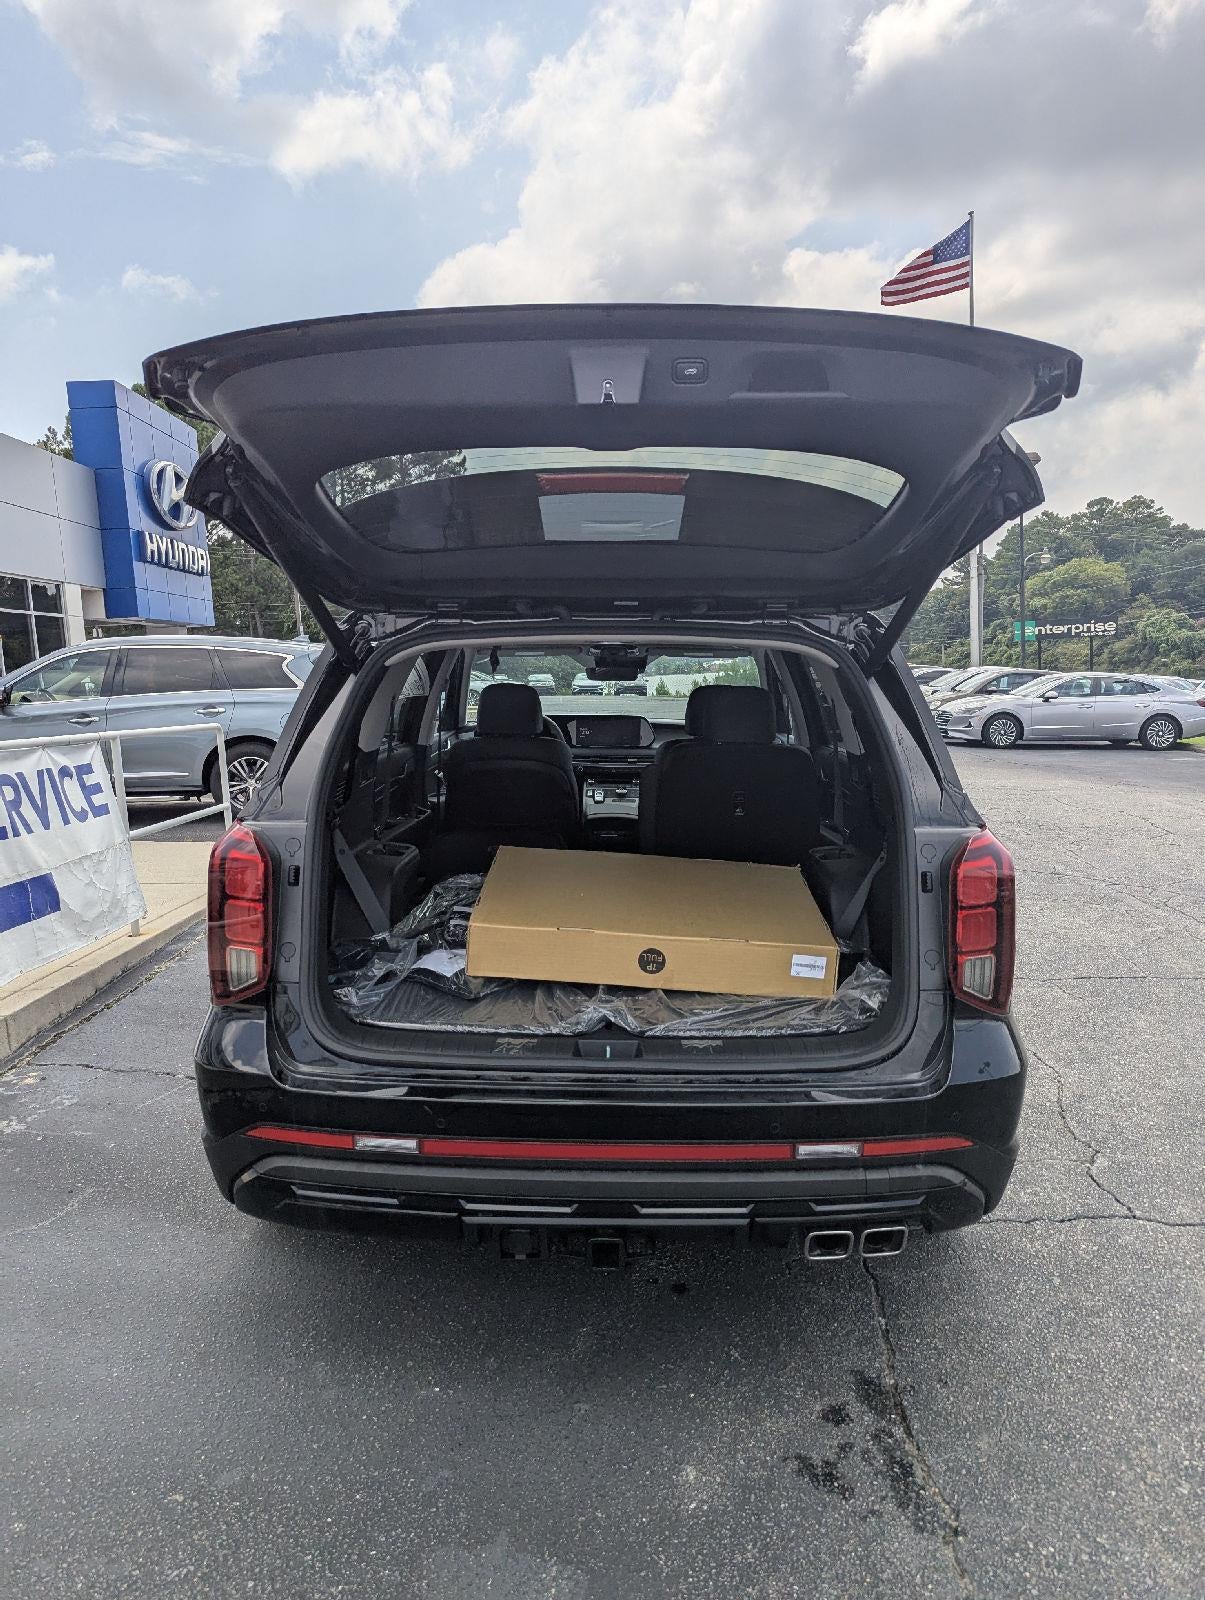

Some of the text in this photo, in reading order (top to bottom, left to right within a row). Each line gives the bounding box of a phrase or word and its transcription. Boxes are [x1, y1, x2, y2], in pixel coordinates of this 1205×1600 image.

[144, 531, 210, 576] HYUNDAI
[1024, 619, 1117, 636] enterprise
[0, 762, 110, 840] RVICE
[641, 954, 663, 962] FULL
